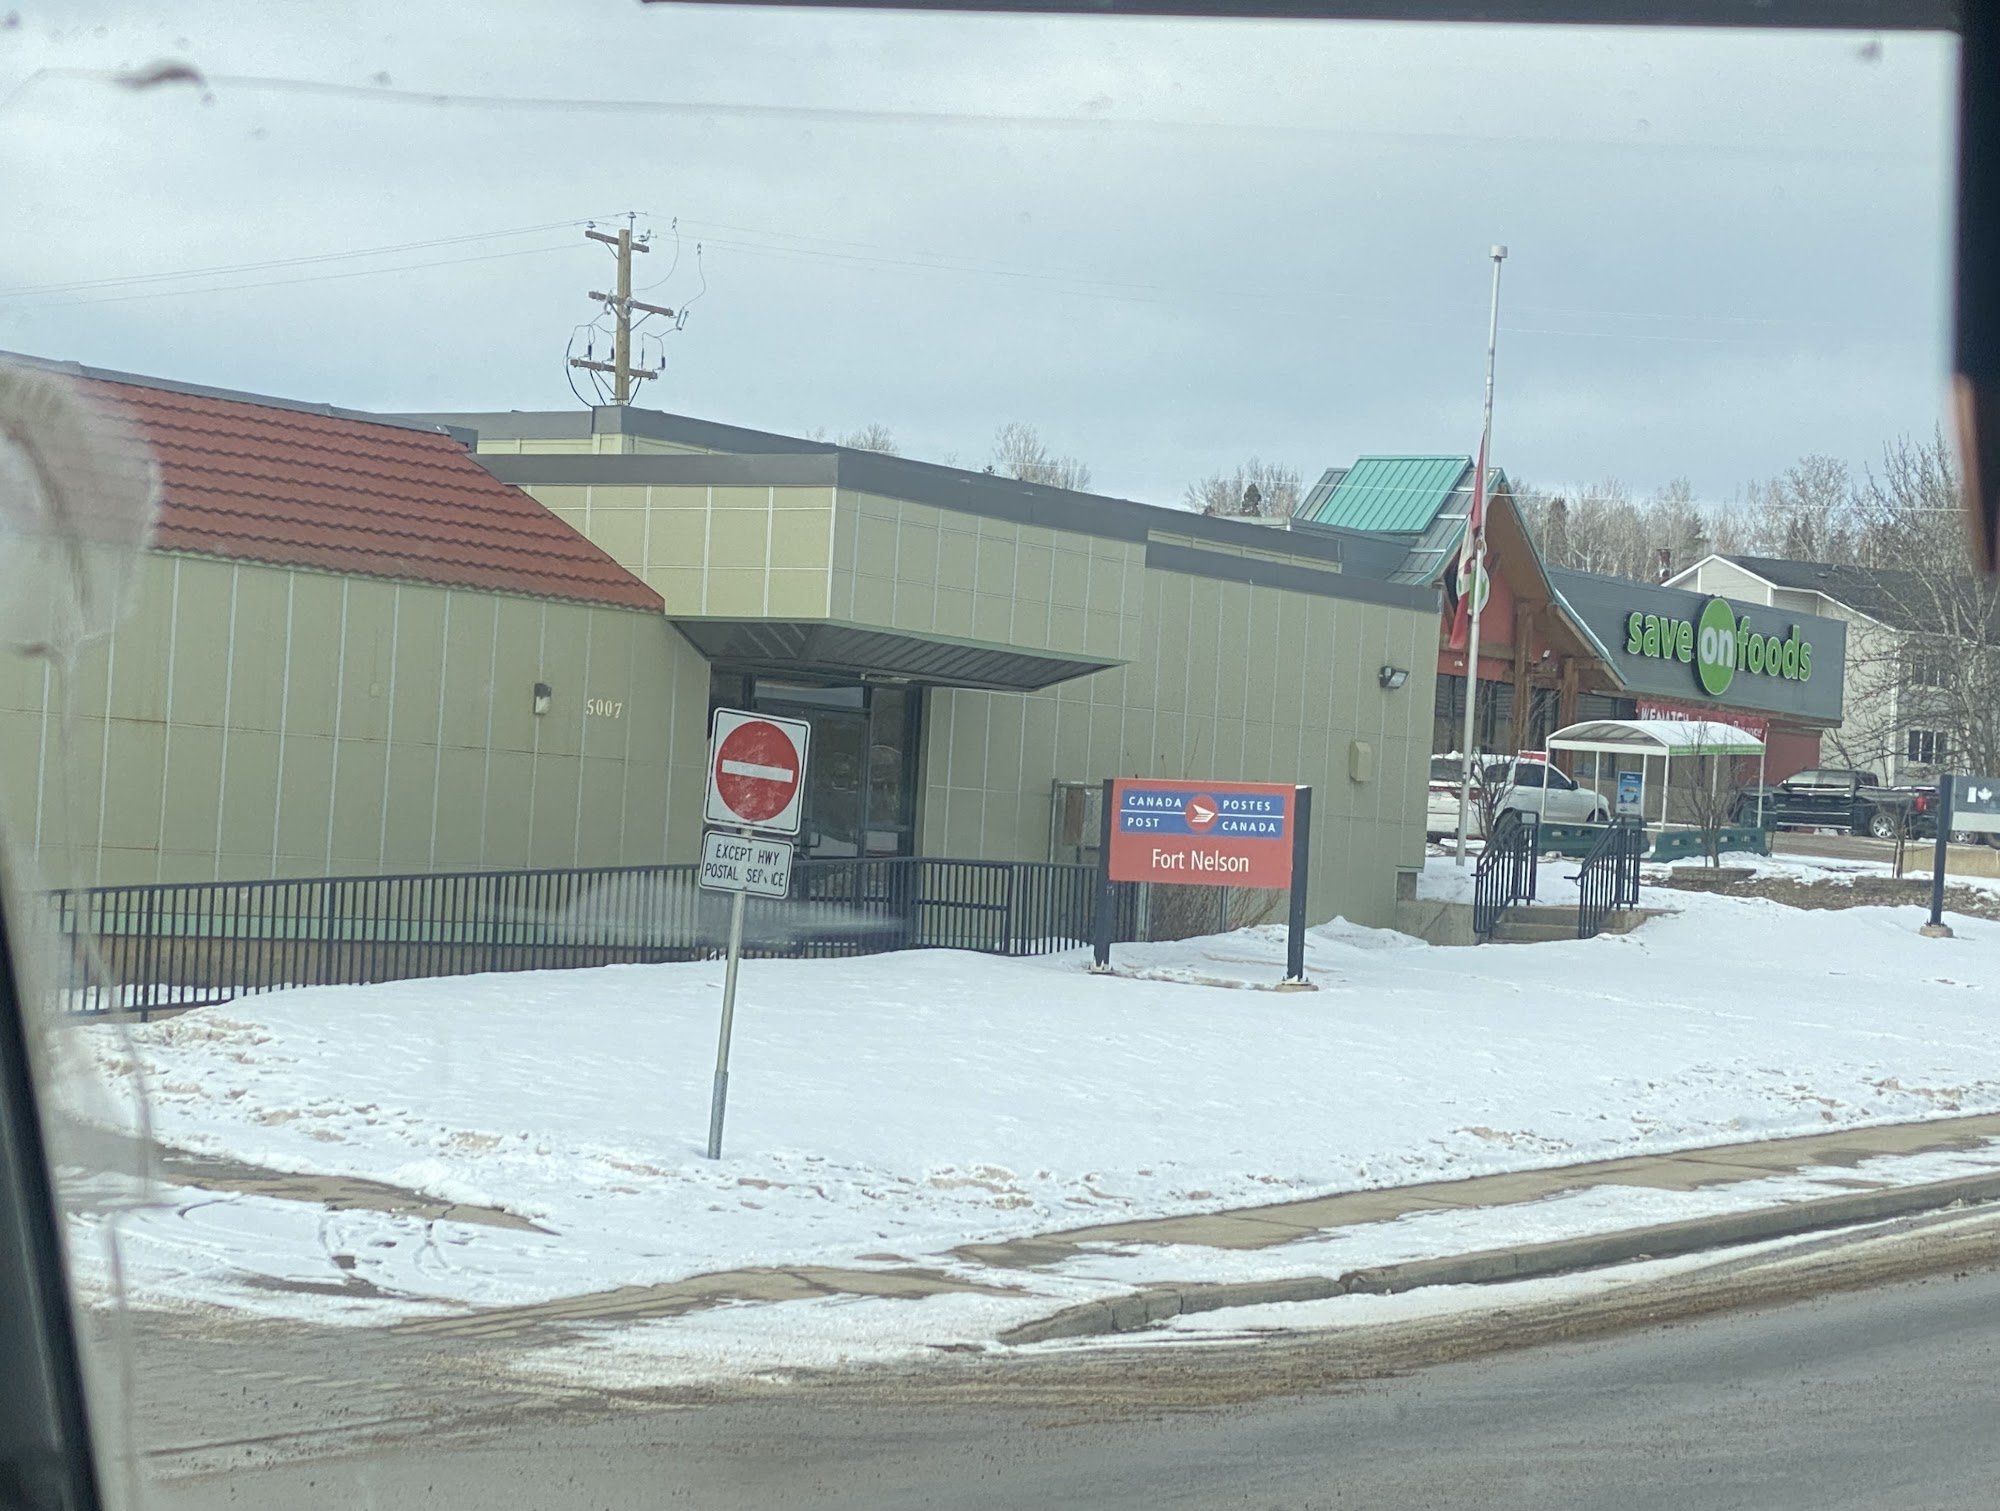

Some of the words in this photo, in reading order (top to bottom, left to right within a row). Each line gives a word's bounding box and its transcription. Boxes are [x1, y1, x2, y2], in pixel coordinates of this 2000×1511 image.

[1628, 612, 1693, 663] save
[1701, 626, 1734, 668] on
[1737, 615, 1812, 682] foods
[586, 698, 623, 719] 5007
[1128, 795, 1183, 809] CANADA
[1222, 799, 1271, 811] POSTES
[1127, 816, 1160, 829] POST
[1221, 820, 1276, 834] CANADA
[715, 843, 753, 863] EXCEPT
[757, 848, 780, 867] HWY
[1152, 848, 1185, 870] Fort
[1191, 850, 1250, 873] Nelson
[704, 862, 739, 882] POSTAL
